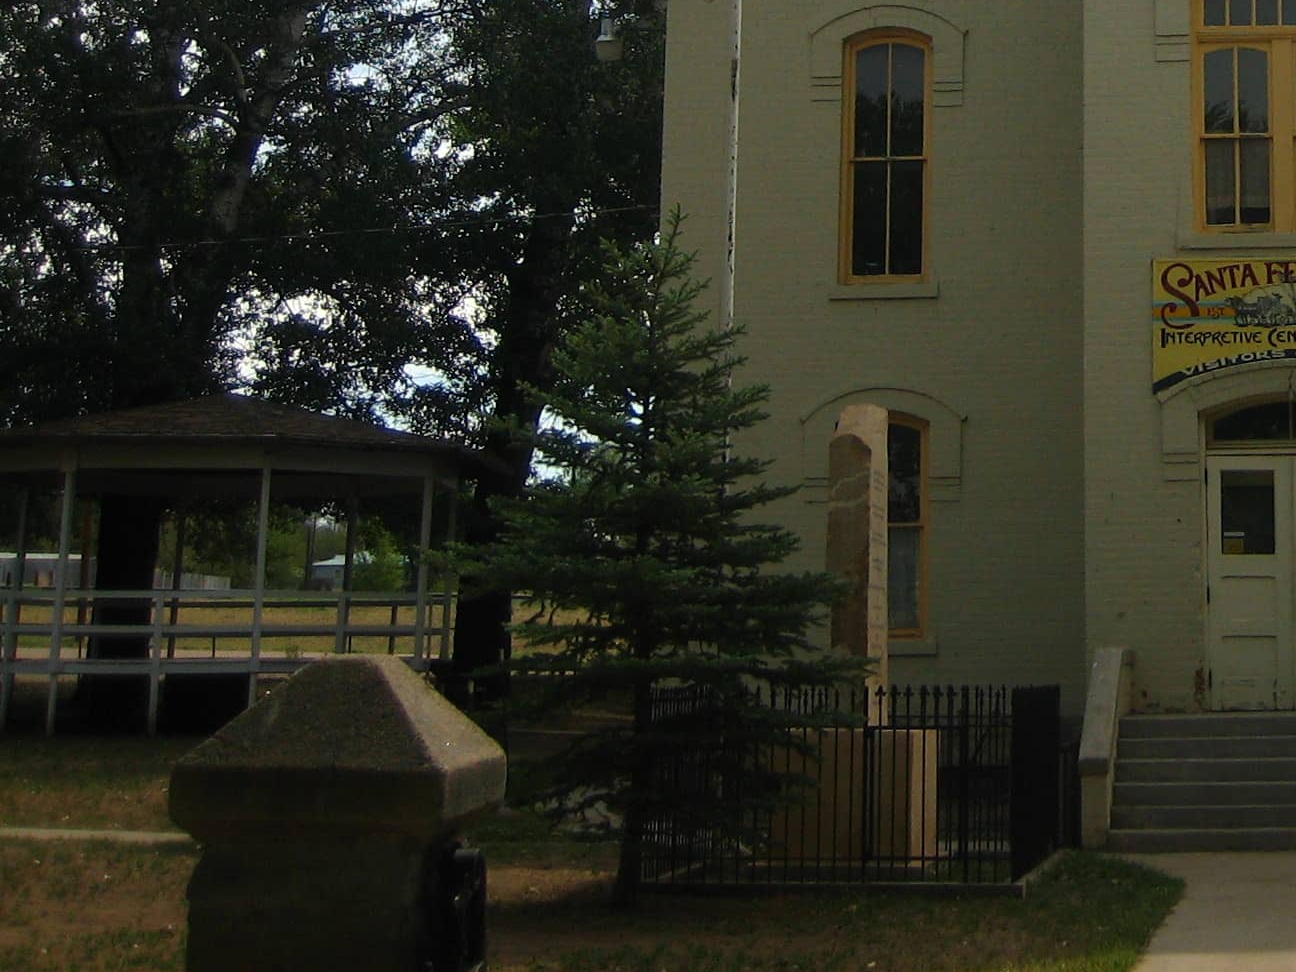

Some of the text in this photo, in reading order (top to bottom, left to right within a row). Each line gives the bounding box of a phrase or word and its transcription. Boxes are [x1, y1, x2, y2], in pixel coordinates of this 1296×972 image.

[1161, 263, 1259, 329] SANTA
[1161, 327, 1262, 348] INTERPRETIVE
[1180, 350, 1286, 375] VISITORS
